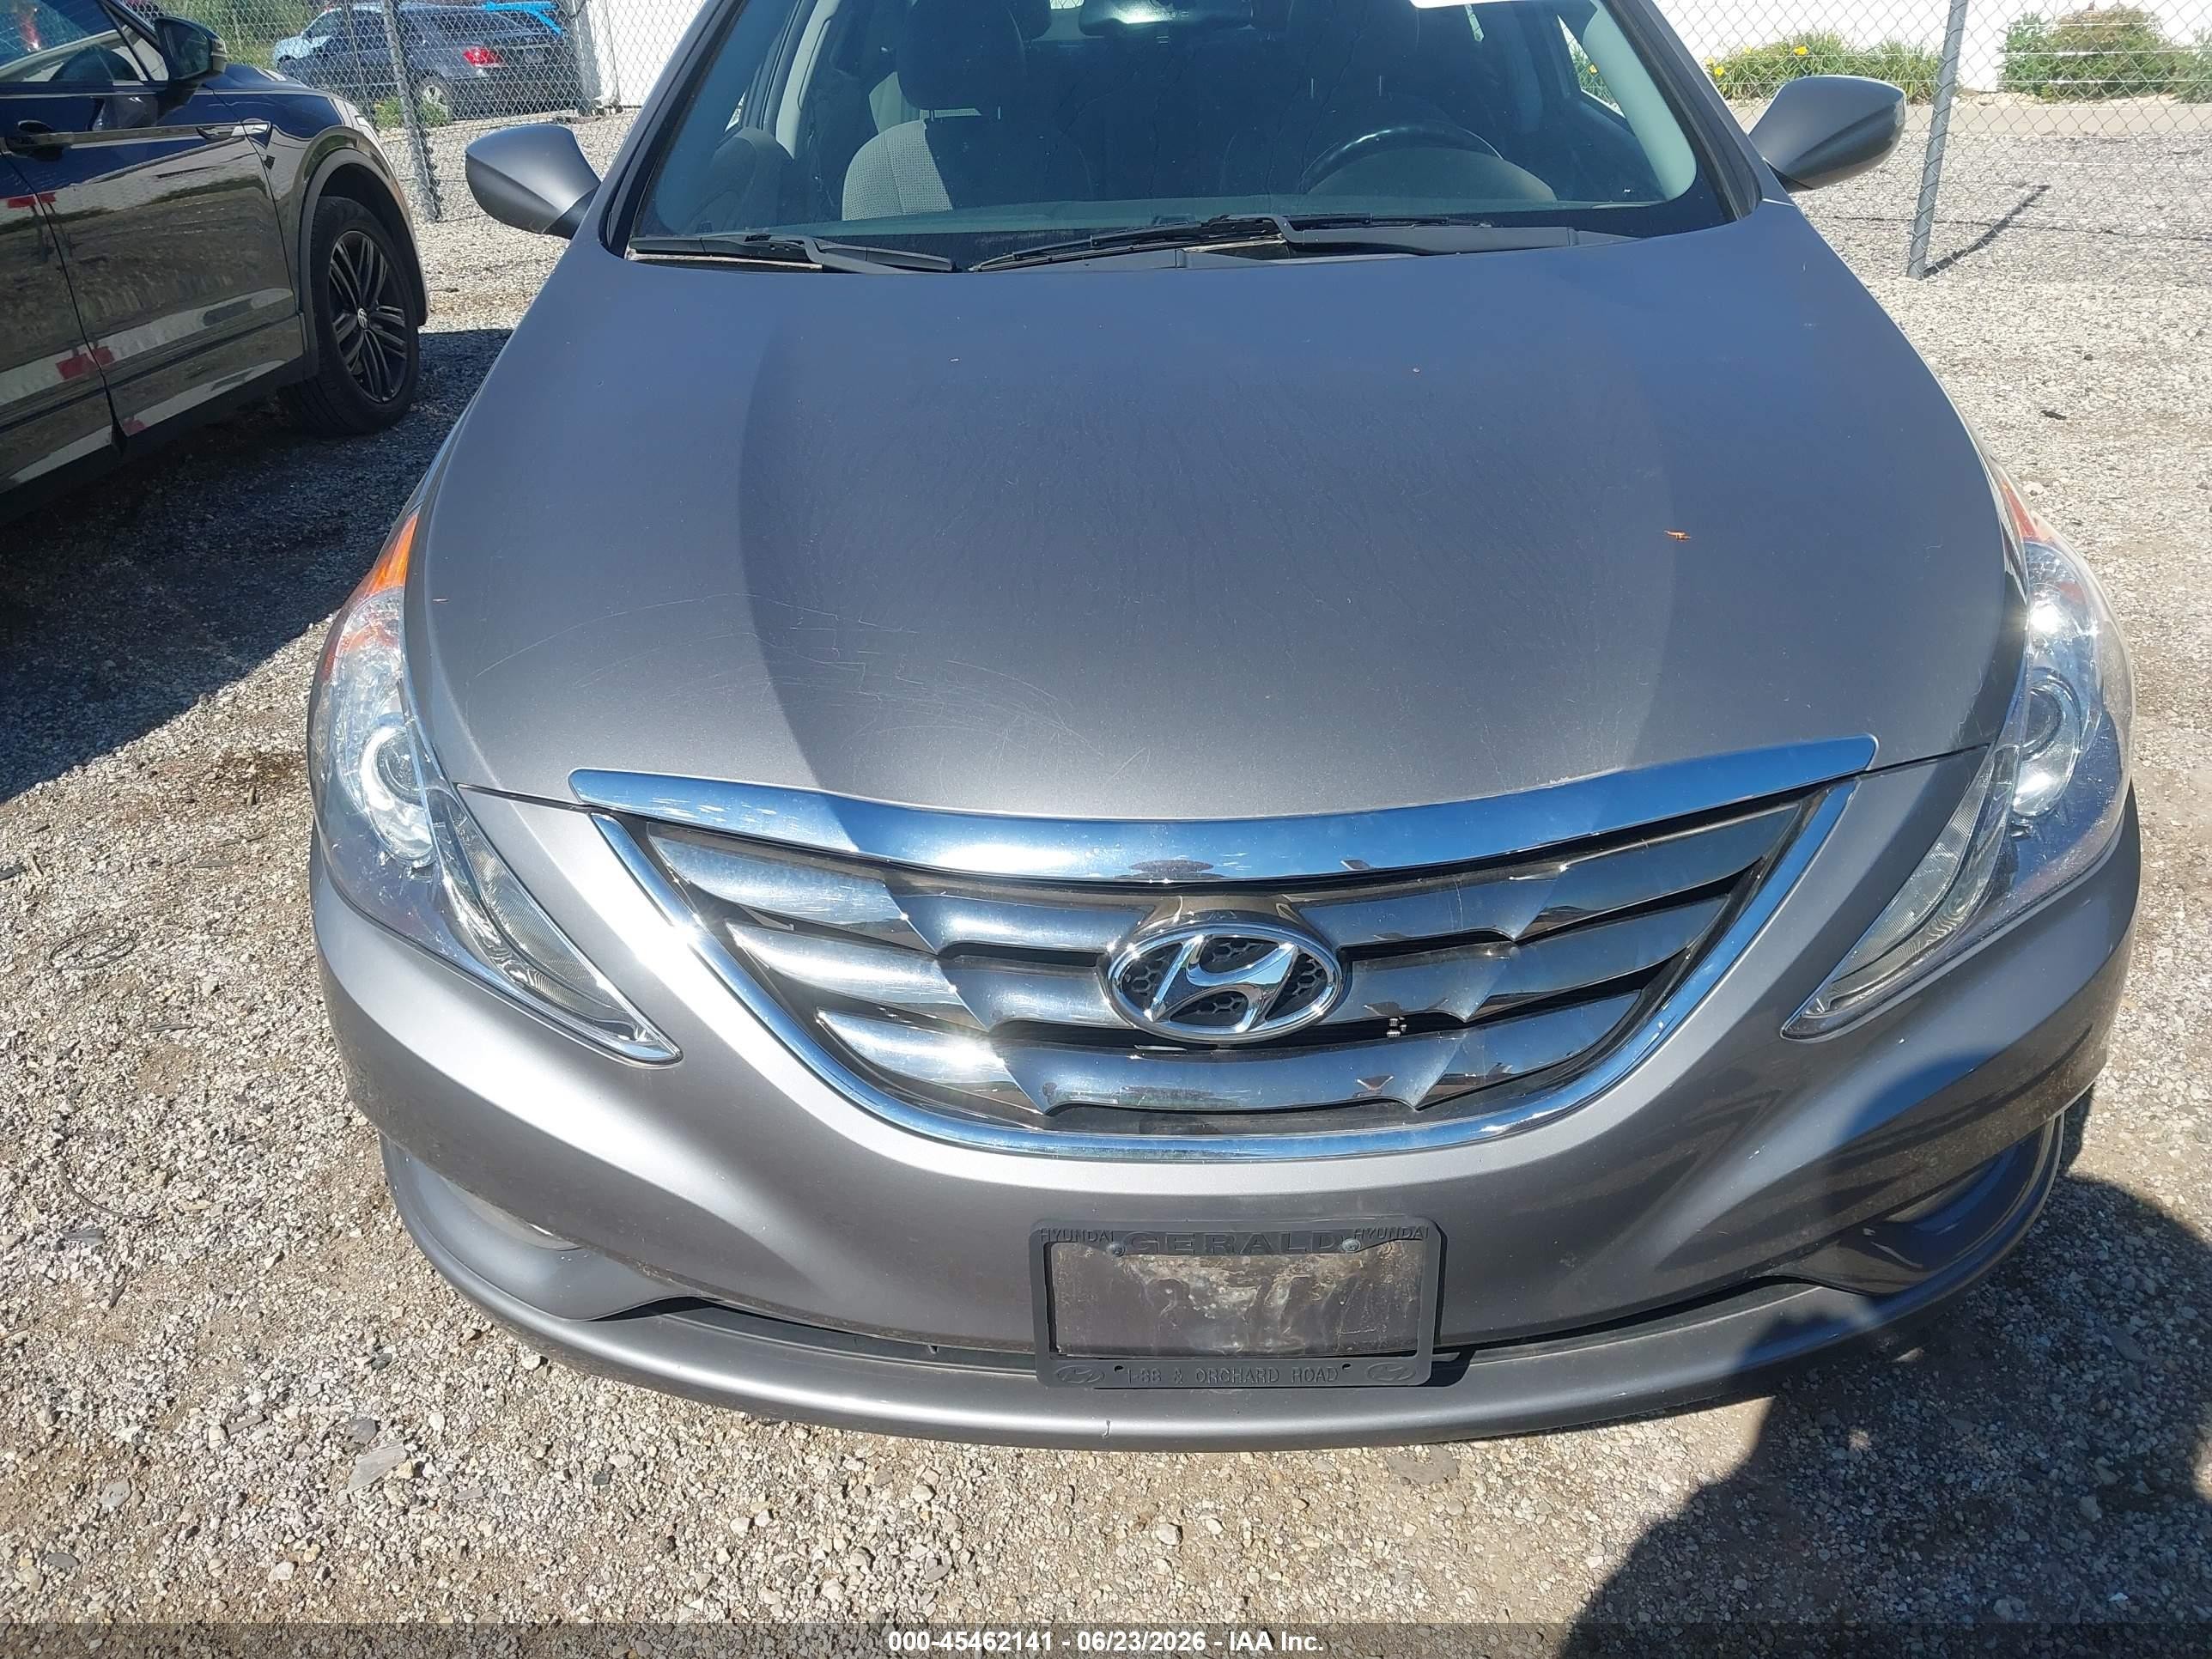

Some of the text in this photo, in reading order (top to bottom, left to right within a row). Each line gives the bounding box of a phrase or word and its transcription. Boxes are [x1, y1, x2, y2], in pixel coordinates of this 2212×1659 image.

[1040, 1229, 1115, 1243] HYUNDAI
[1353, 1226, 1430, 1240] HYUNDAI
[1122, 1231, 1344, 1255] GERALD
[1195, 1367, 1279, 1383] ORCHARD
[1291, 1366, 1339, 1383] ROAD
